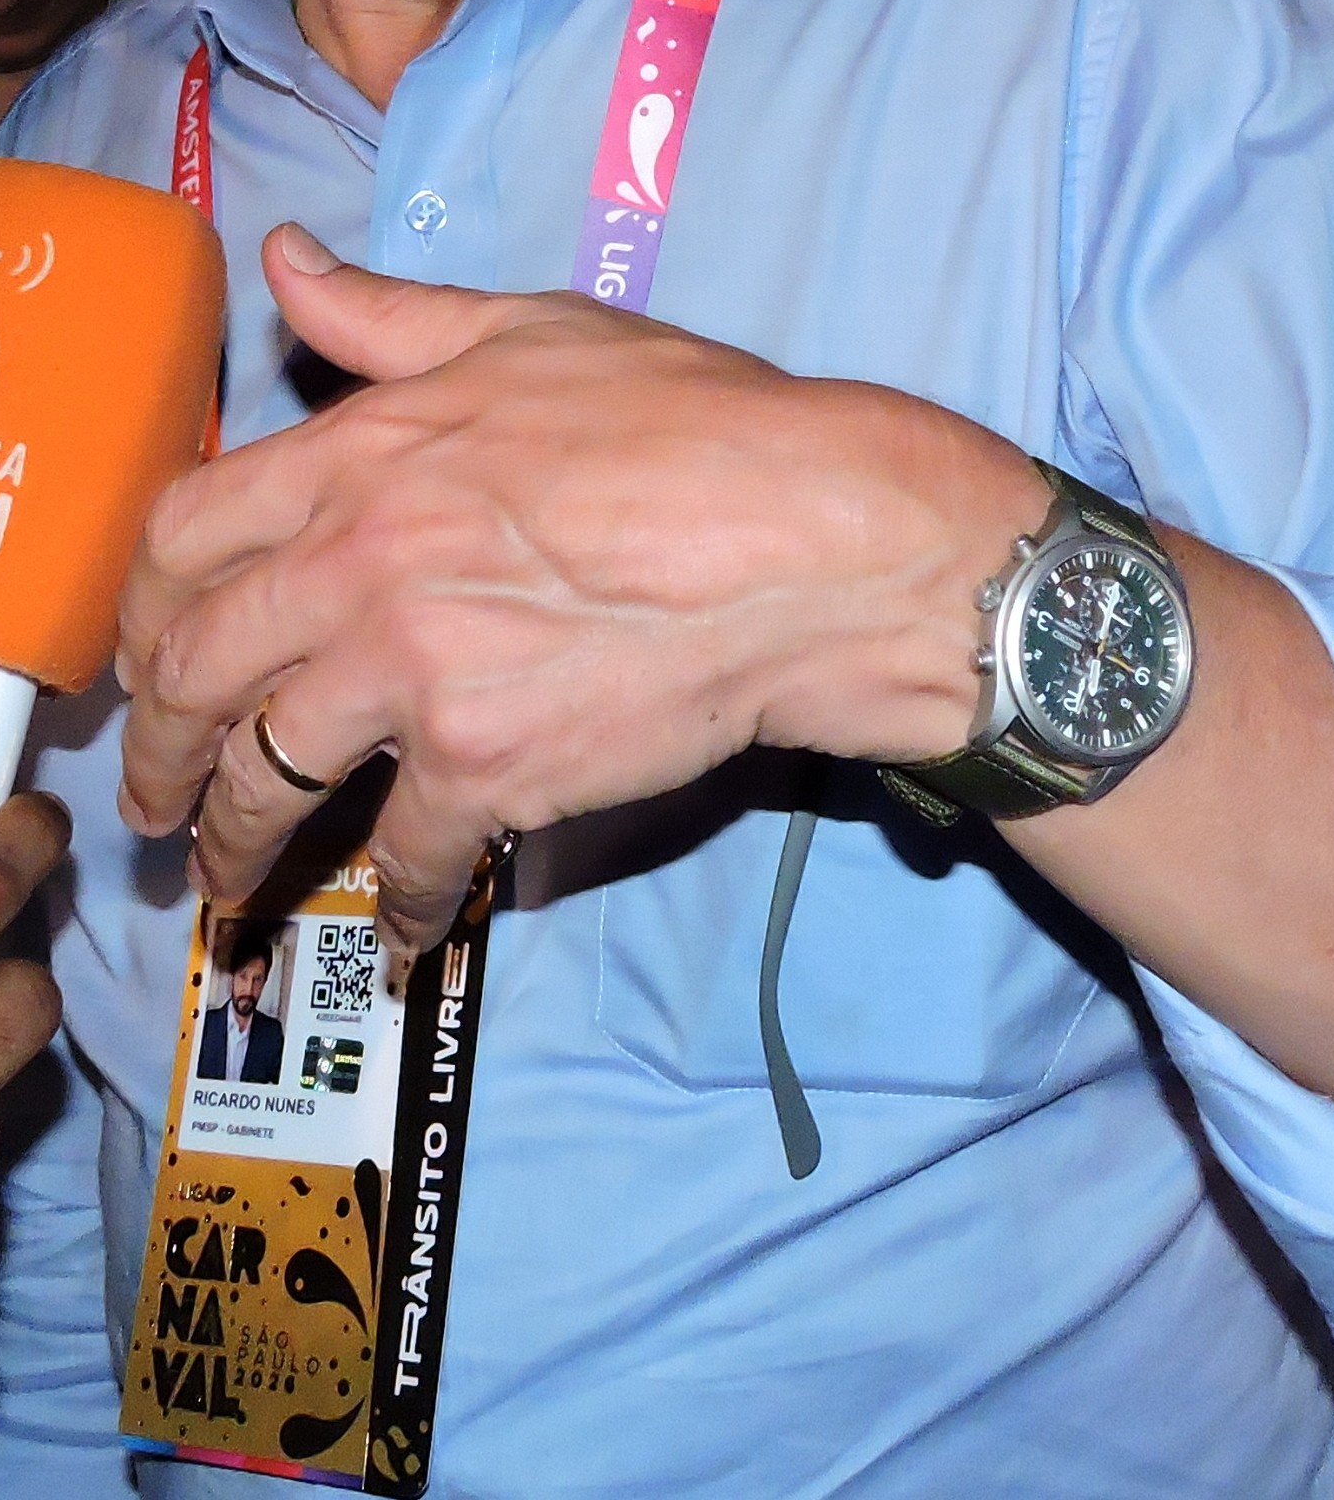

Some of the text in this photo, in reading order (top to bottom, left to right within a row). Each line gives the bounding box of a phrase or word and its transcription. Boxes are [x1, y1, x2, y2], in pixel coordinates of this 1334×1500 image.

[180, 78, 203, 205] AMSTE
[593, 239, 635, 299] LIG
[1037, 611, 1054, 632] 3
[1134, 666, 1151, 686] 9
[193, 1089, 316, 1116] RICARDO NUNES
[394, 942, 470, 1397] TRÂNSITO LIVRE
[236, 1344, 321, 1376] PAULO
